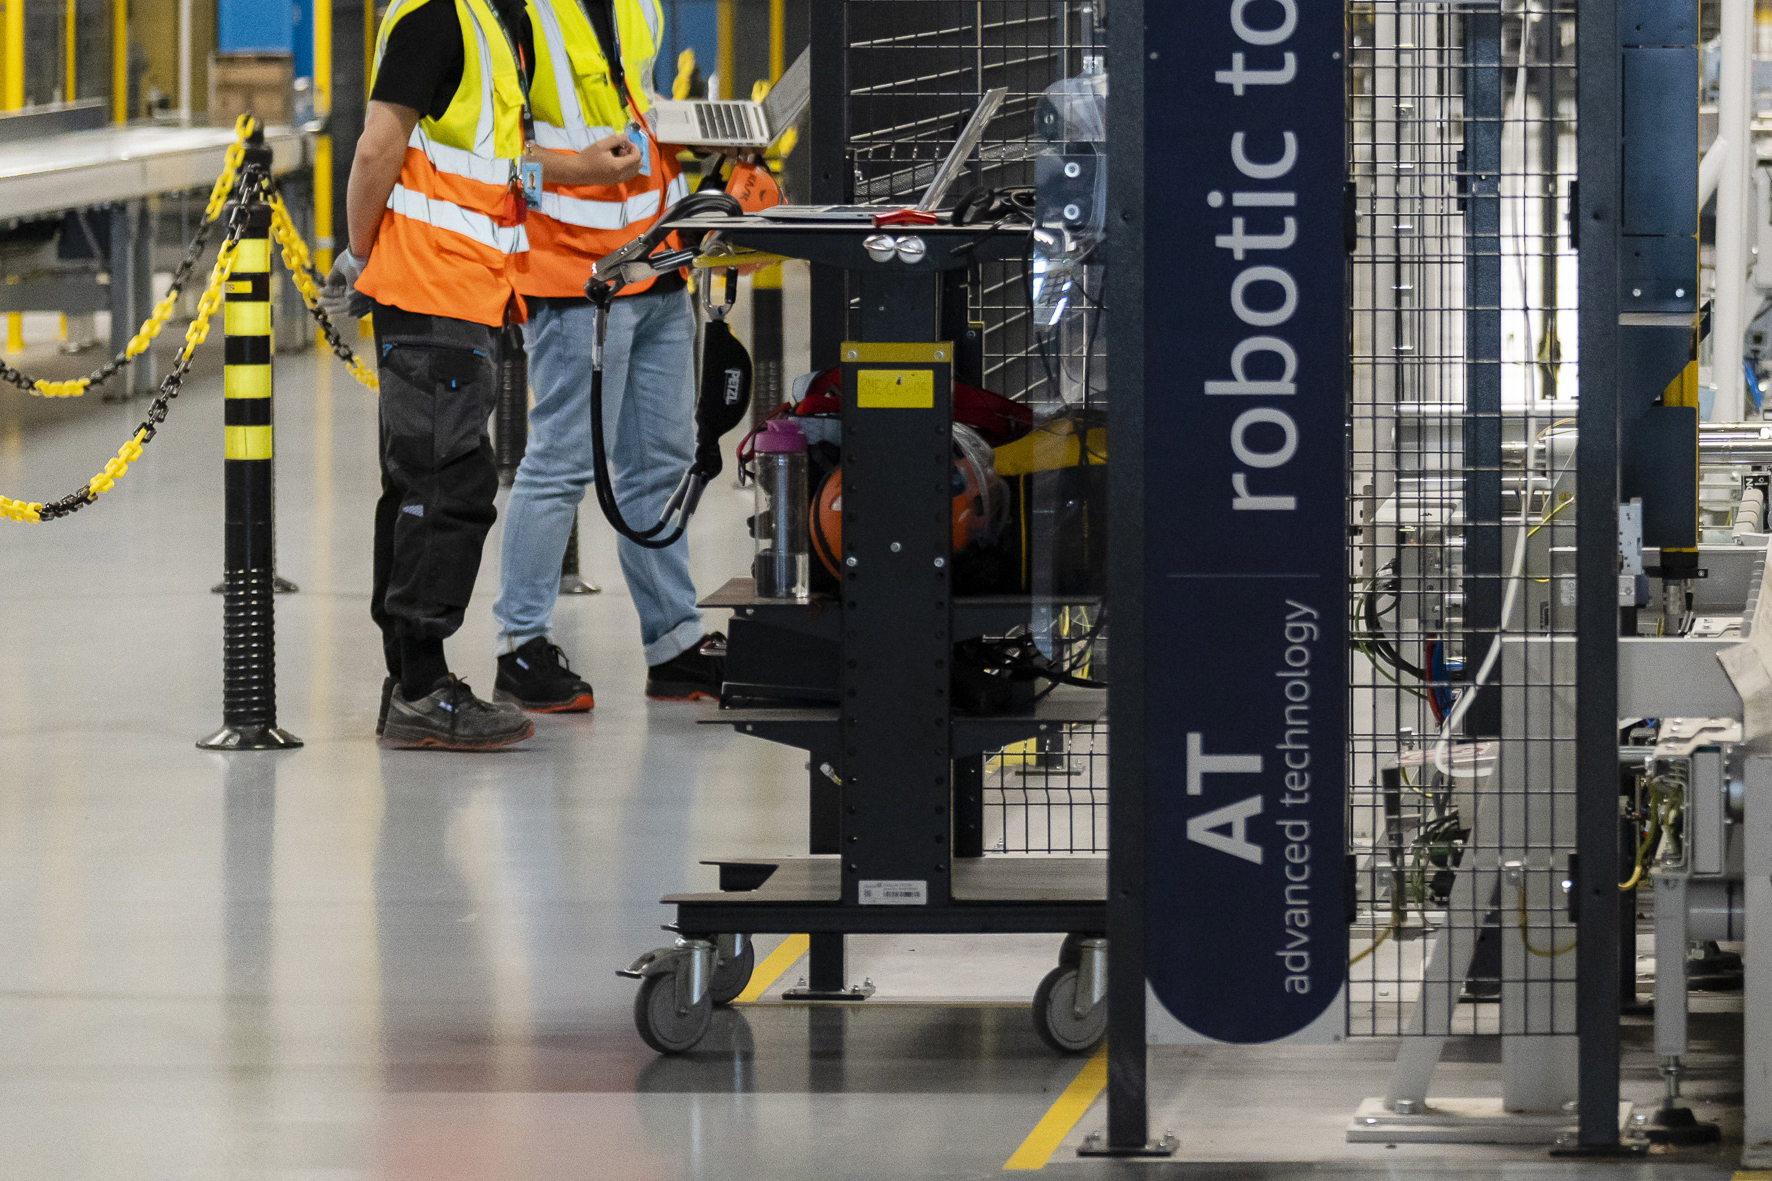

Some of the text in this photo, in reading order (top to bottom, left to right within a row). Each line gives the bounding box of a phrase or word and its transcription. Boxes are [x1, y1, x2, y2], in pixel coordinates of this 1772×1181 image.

[724, 368, 741, 405] PETZL
[1203, 131, 1298, 510] robotic
[1186, 733, 1262, 864] AT
[1275, 598, 1320, 994] advanced technology
